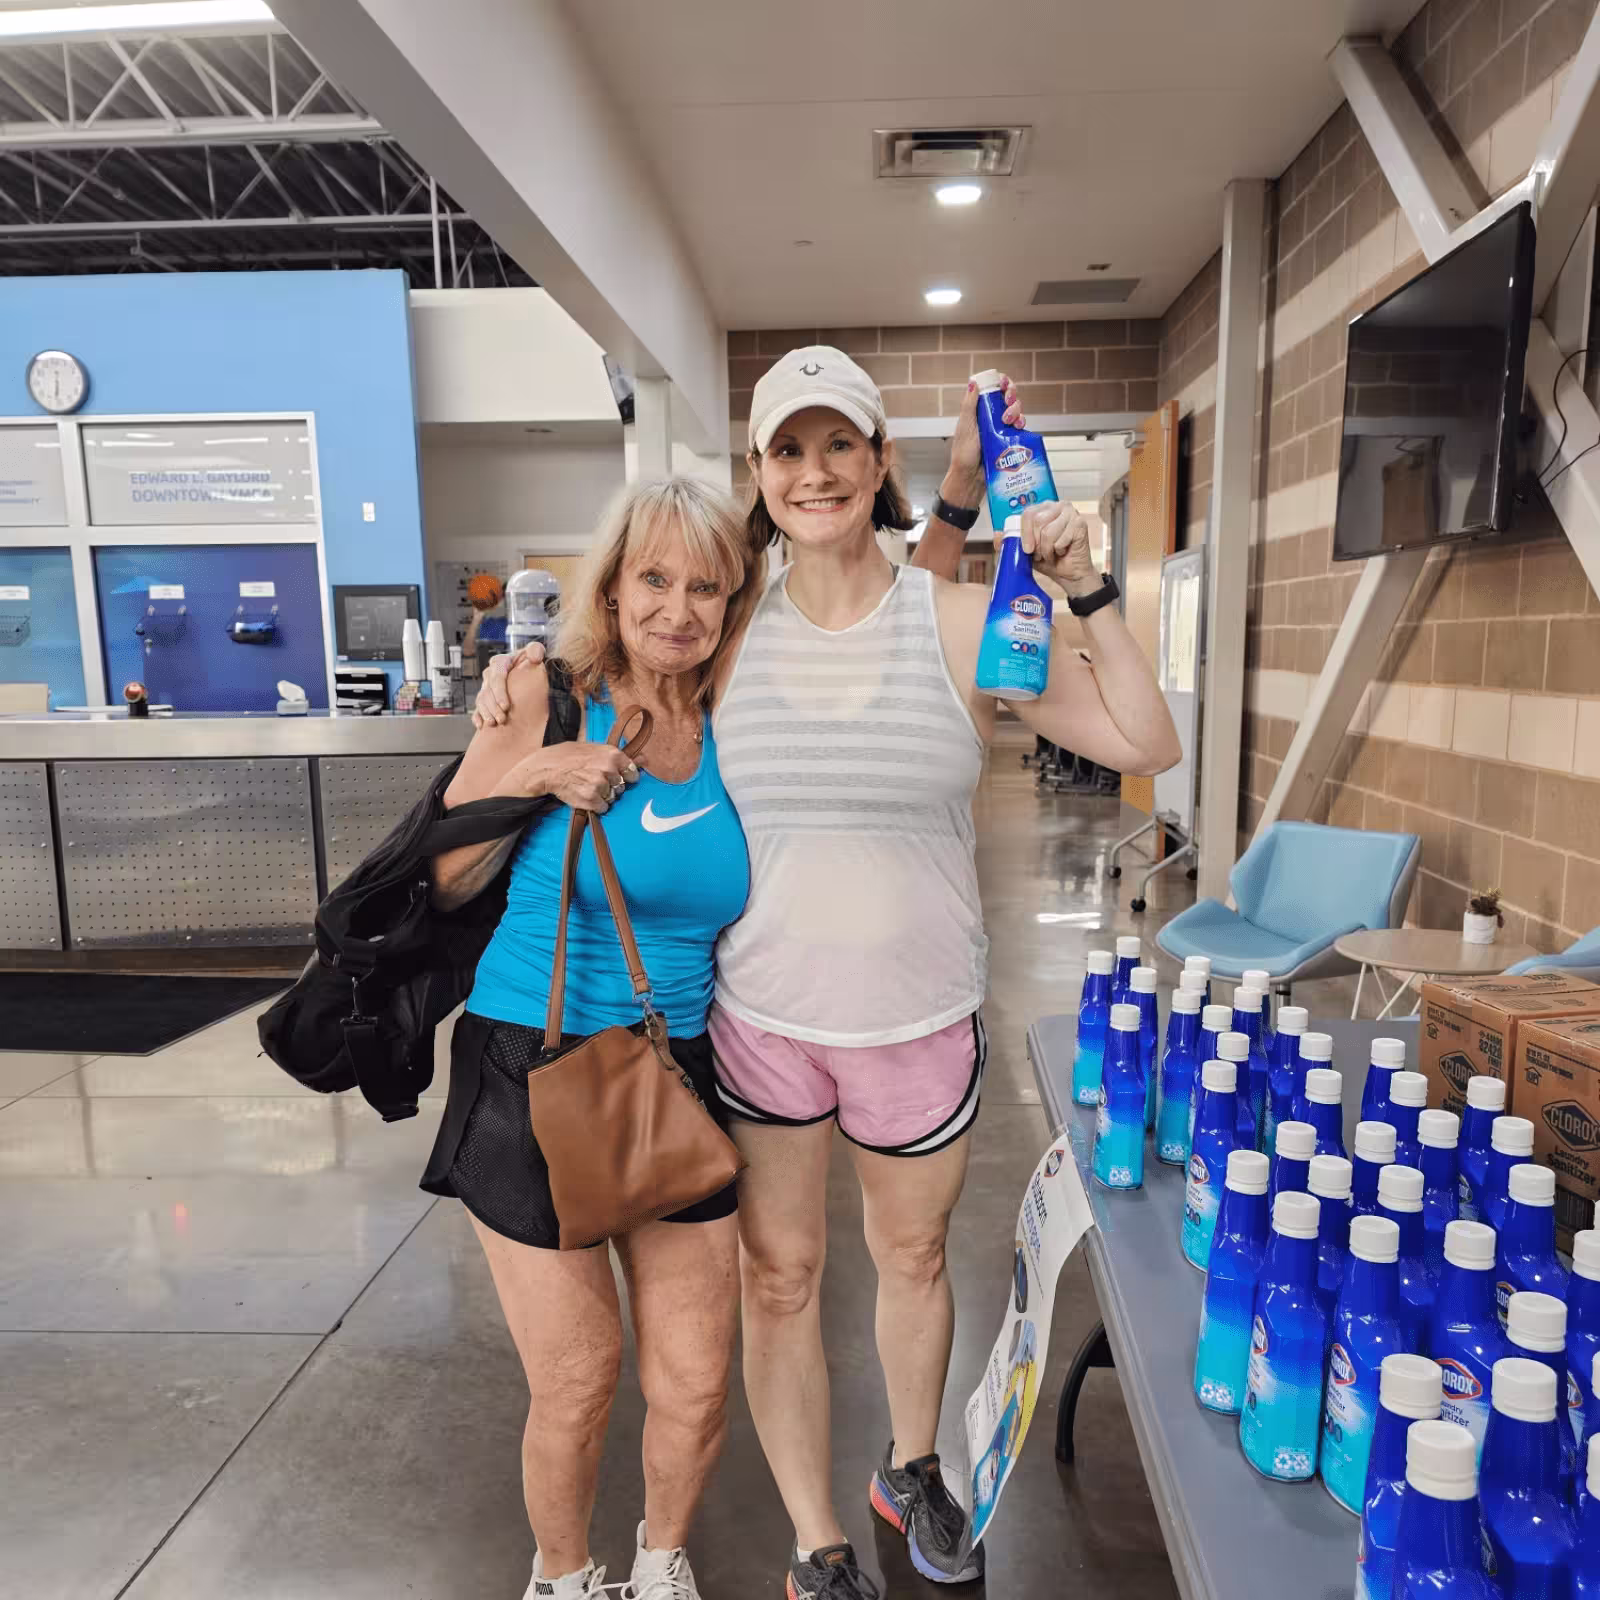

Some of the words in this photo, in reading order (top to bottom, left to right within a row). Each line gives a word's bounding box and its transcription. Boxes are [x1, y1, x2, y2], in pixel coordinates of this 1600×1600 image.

[999, 449, 1029, 469] CLOROX
[130, 473, 188, 484] EDWARD
[1014, 601, 1042, 614] CLOROX
[1550, 1107, 1598, 1145] CLOROX
[1554, 1145, 1589, 1169] Laundry
[1547, 1153, 1597, 1185] Sanitizer
[1442, 1368, 1474, 1396] OROX
[1440, 1400, 1464, 1415] aundry
[1440, 1407, 1470, 1427] nitizer
